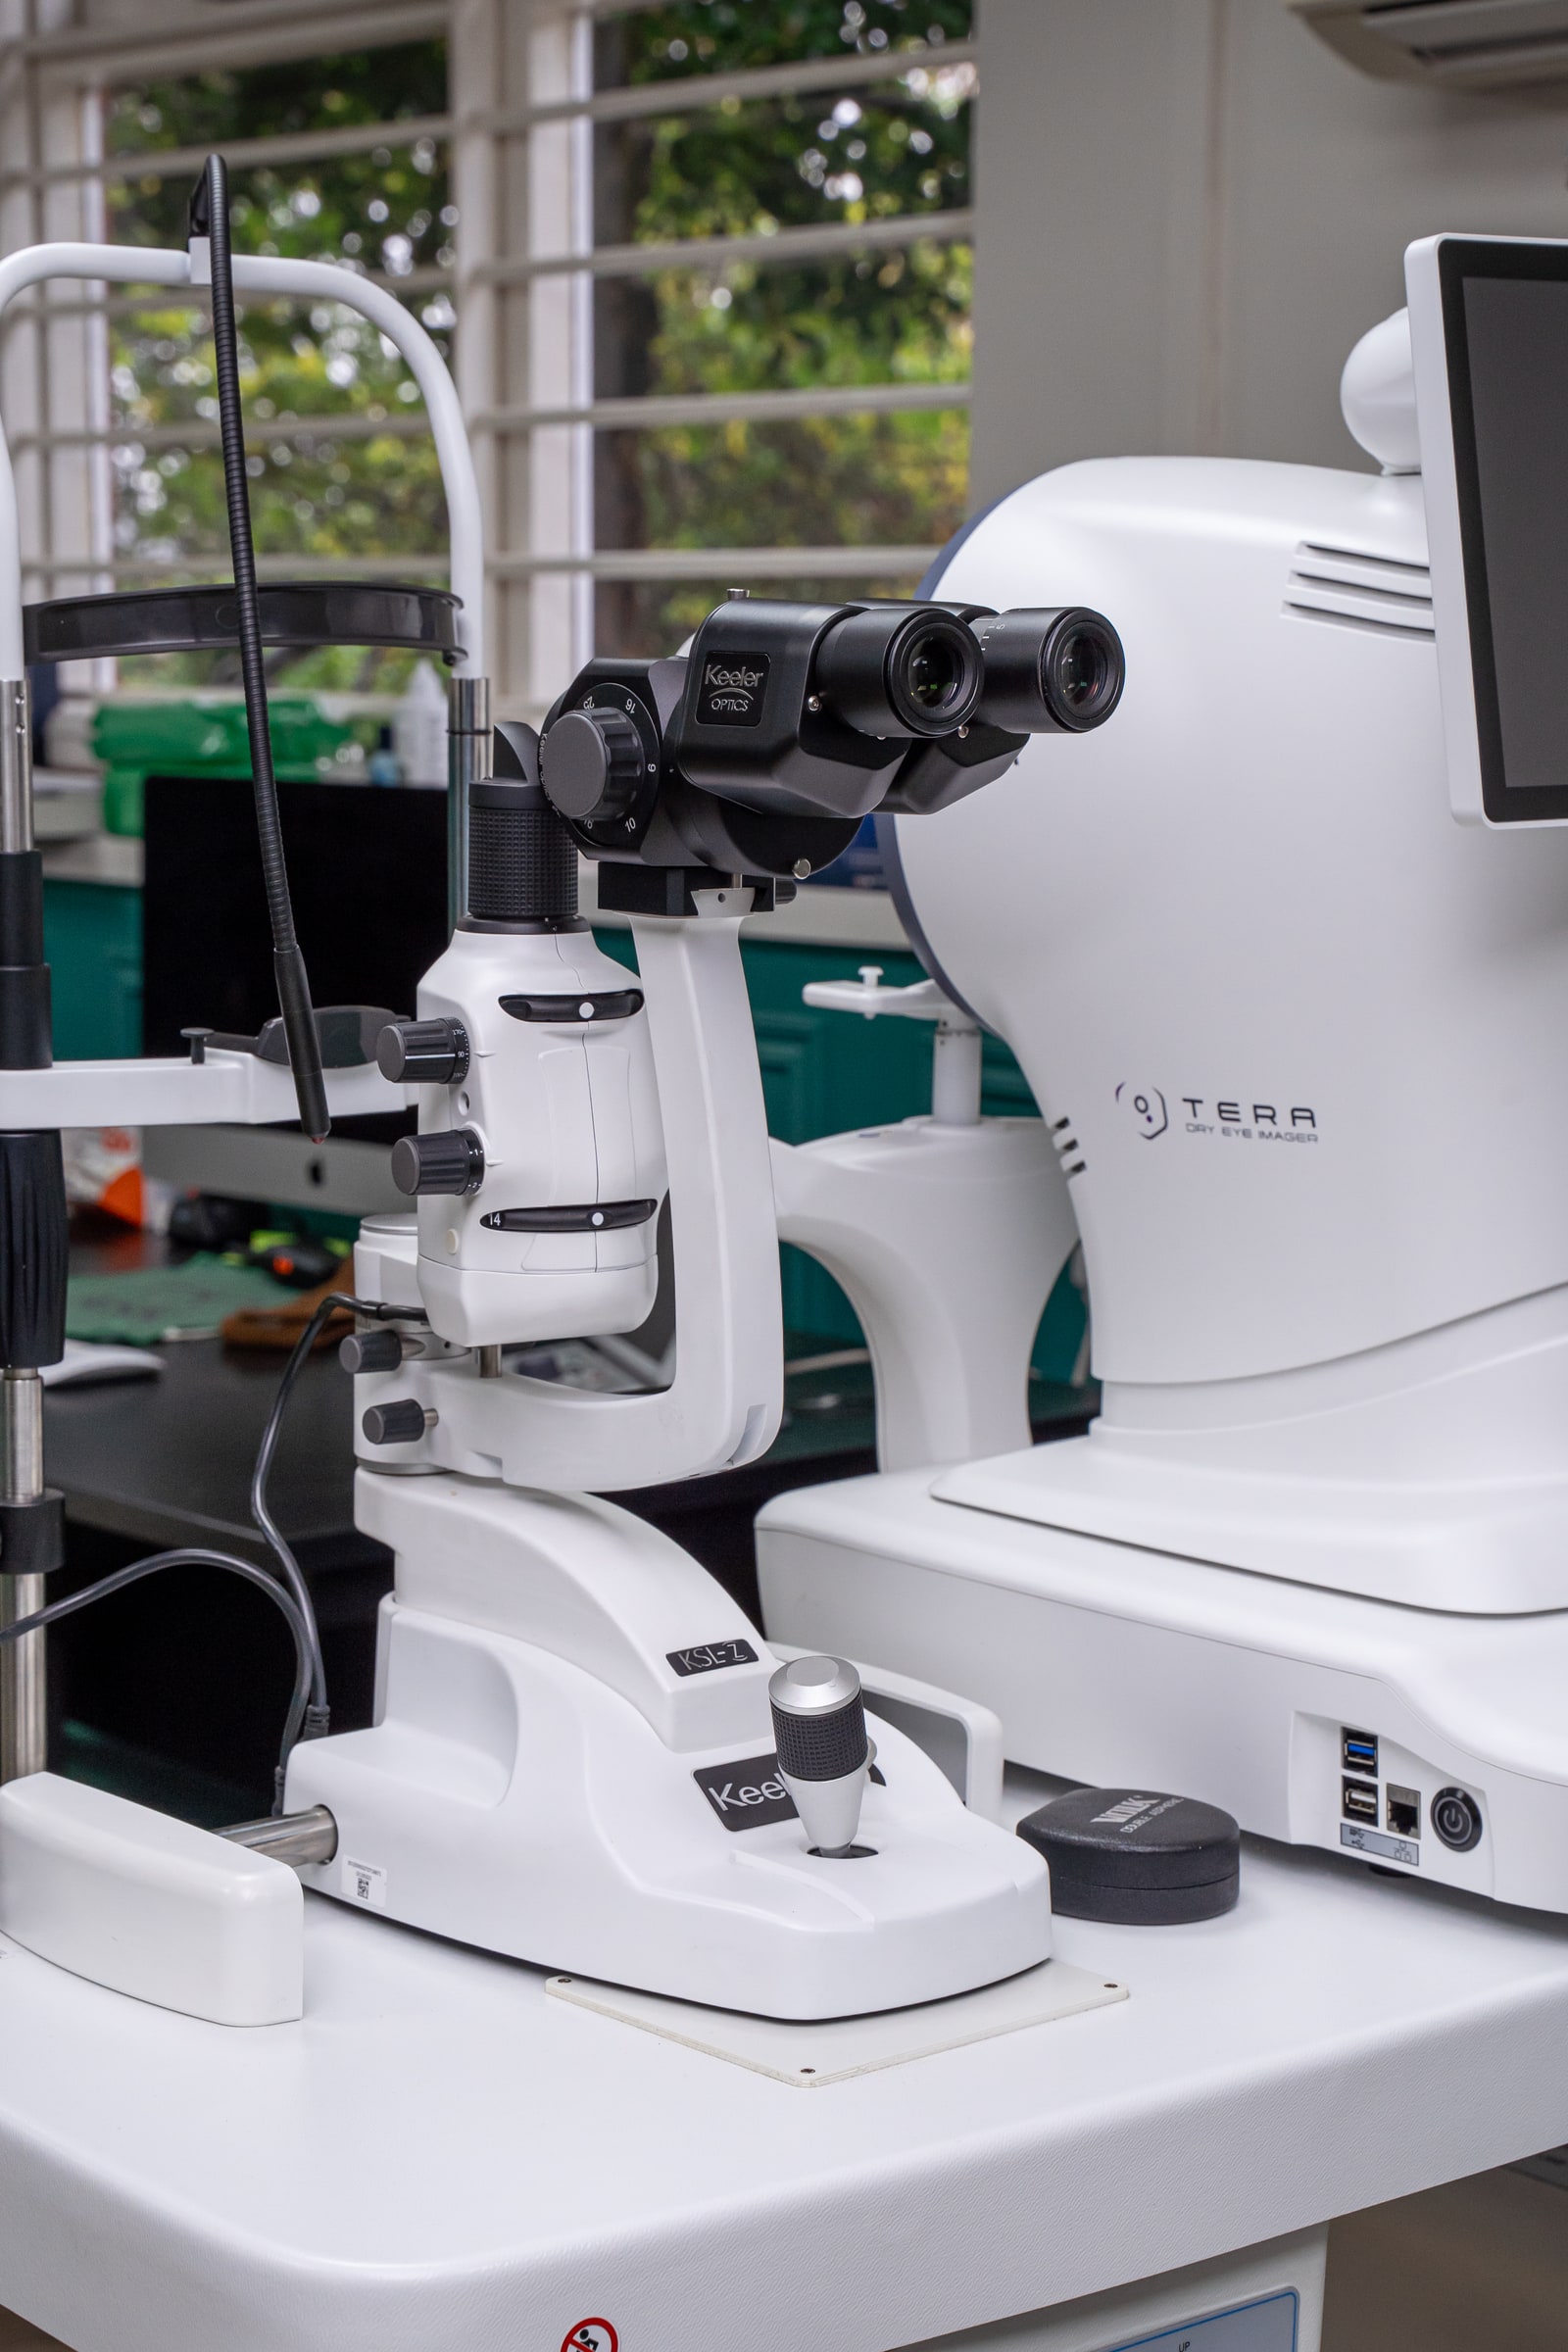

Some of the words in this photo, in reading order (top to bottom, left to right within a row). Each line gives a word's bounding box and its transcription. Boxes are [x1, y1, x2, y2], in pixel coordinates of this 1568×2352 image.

[705, 664, 764, 687] Keeler
[625, 698, 636, 713] 16
[710, 698, 750, 711] OPTICS
[624, 817, 636, 833] 10
[1182, 1098, 1316, 1128] TERA
[1186, 1123, 1215, 1134] DRY
[1222, 1126, 1253, 1139] EYE
[1258, 1130, 1319, 1144] IMAGER
[488, 1212, 501, 1226] 14
[708, 1772, 791, 1811] Keel
[1178, 2341, 1191, 2352] UP
